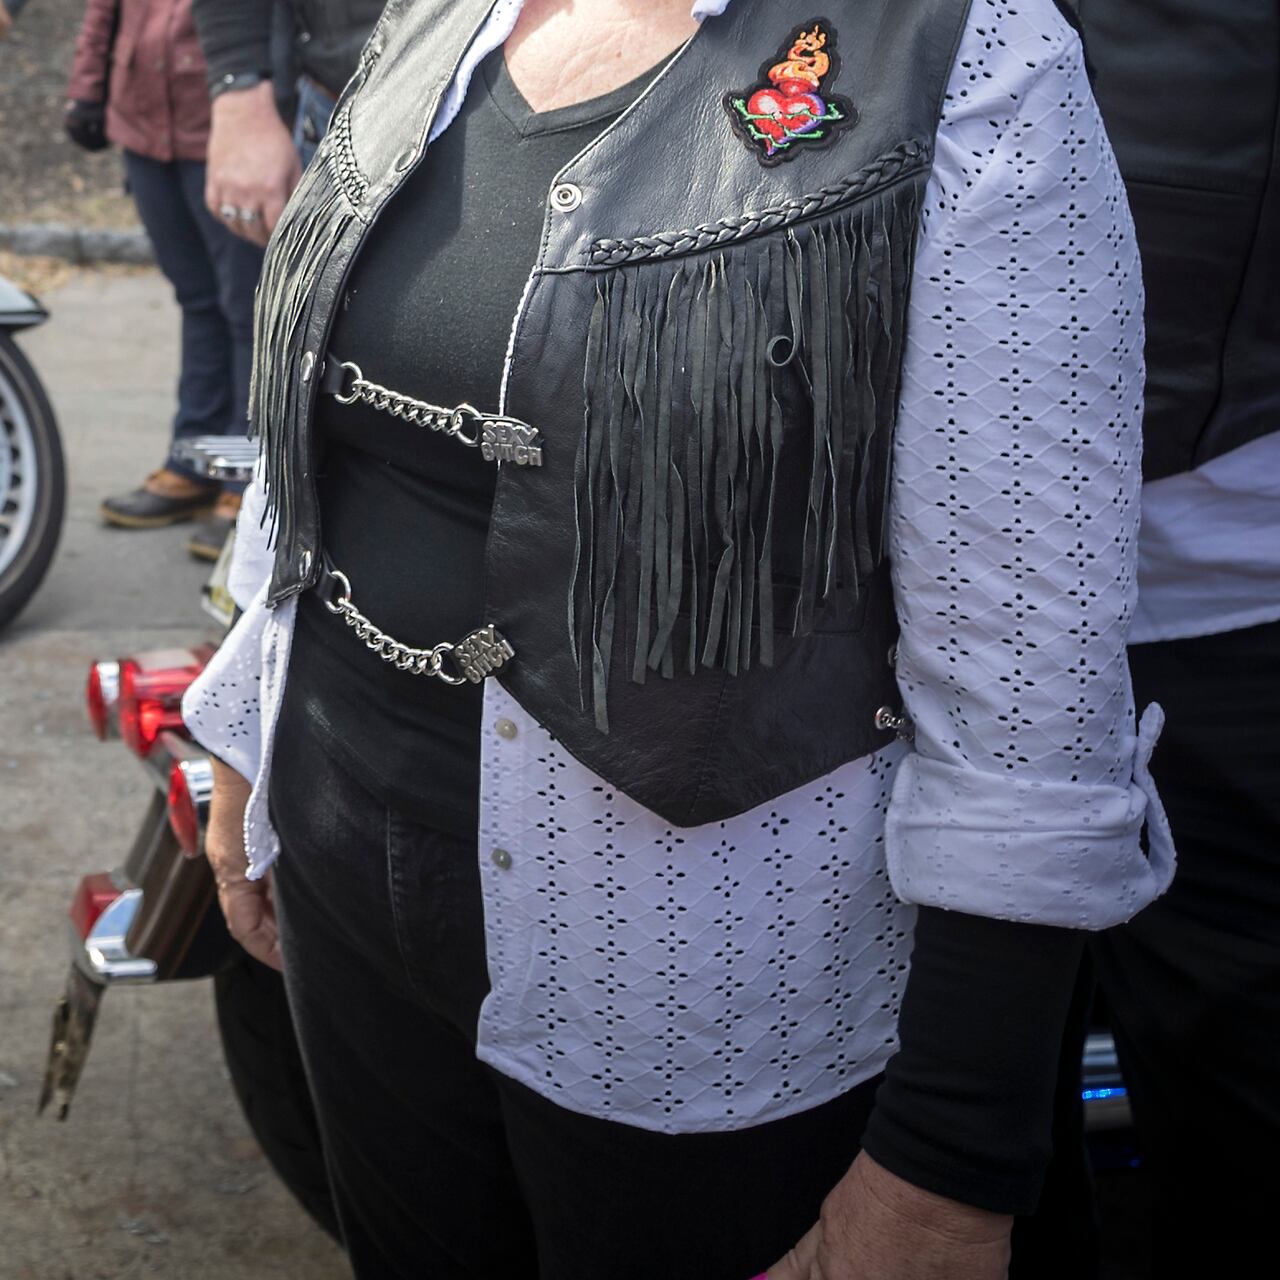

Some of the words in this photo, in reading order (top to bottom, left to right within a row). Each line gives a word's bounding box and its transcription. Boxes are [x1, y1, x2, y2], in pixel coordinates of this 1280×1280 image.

[482, 421, 539, 446] SEXY
[455, 624, 495, 667] SEXY
[465, 639, 515, 684] BITCH
